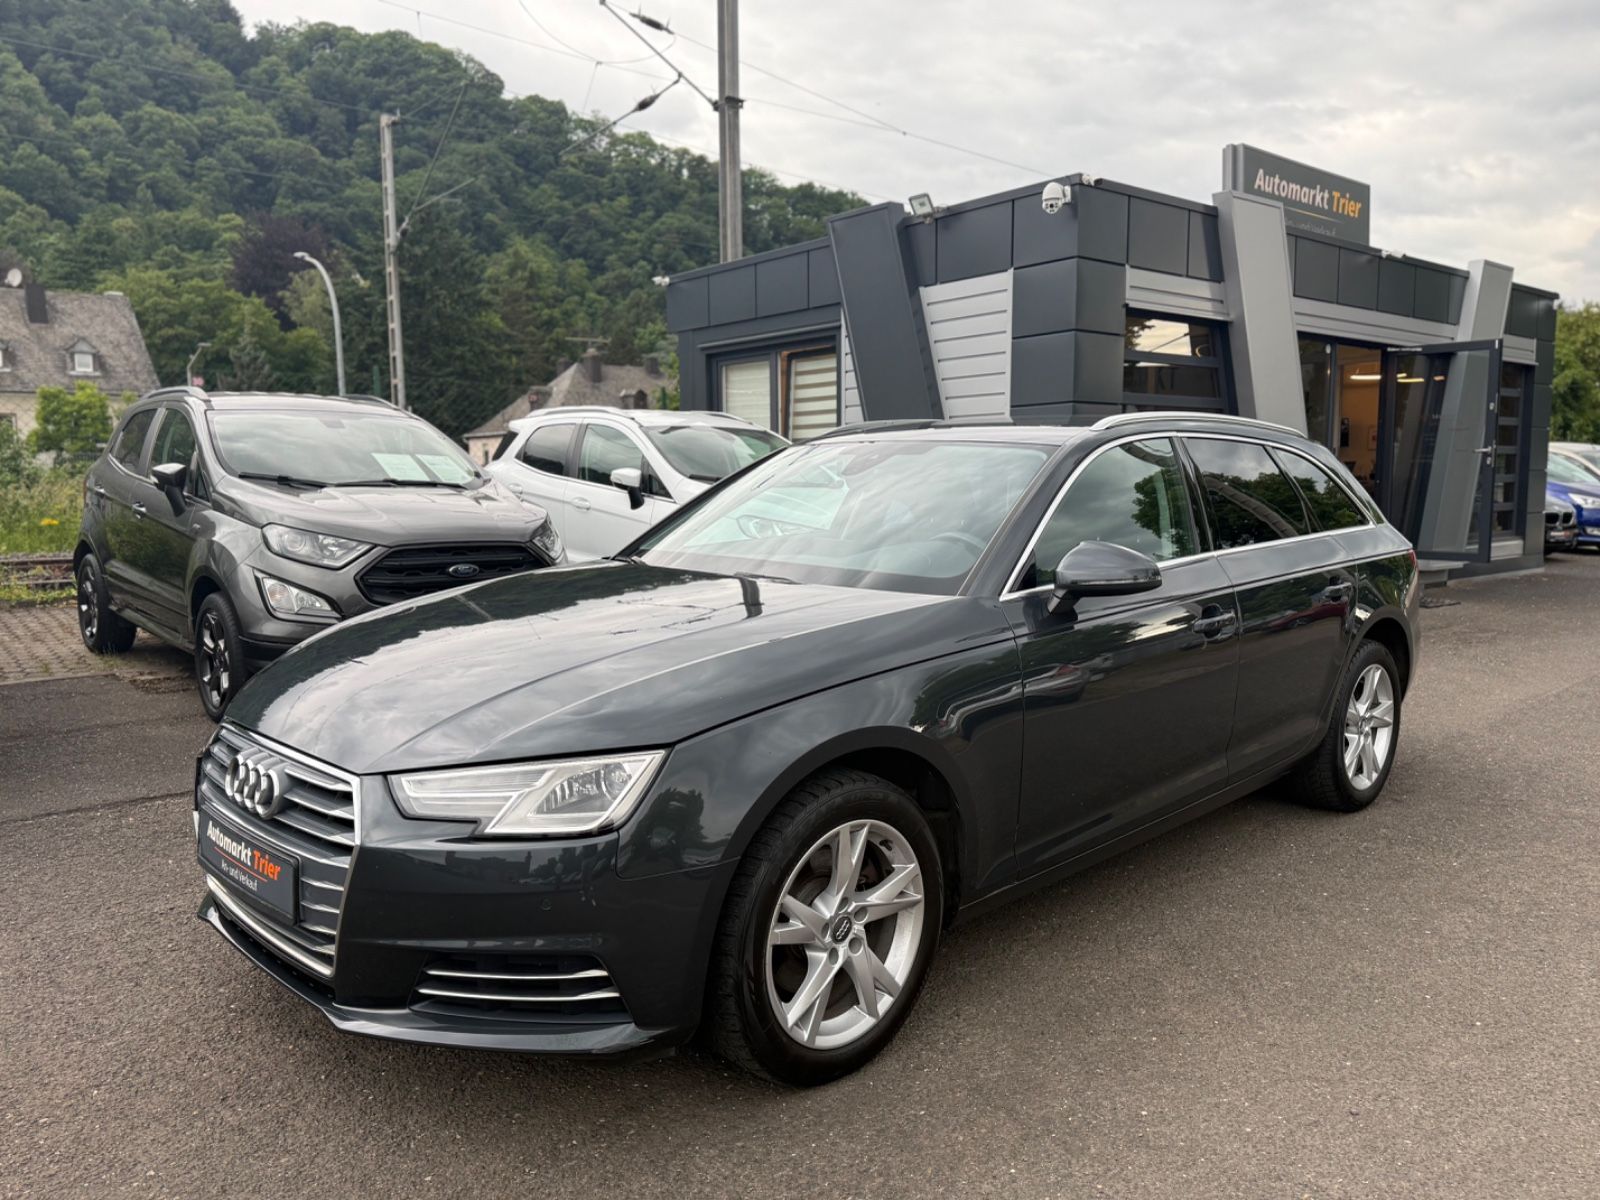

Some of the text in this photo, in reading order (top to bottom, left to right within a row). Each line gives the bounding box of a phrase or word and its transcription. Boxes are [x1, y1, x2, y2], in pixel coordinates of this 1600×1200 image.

[1254, 168, 1362, 218] Automarkt Trier
[207, 820, 281, 880] Automarkt Trier
